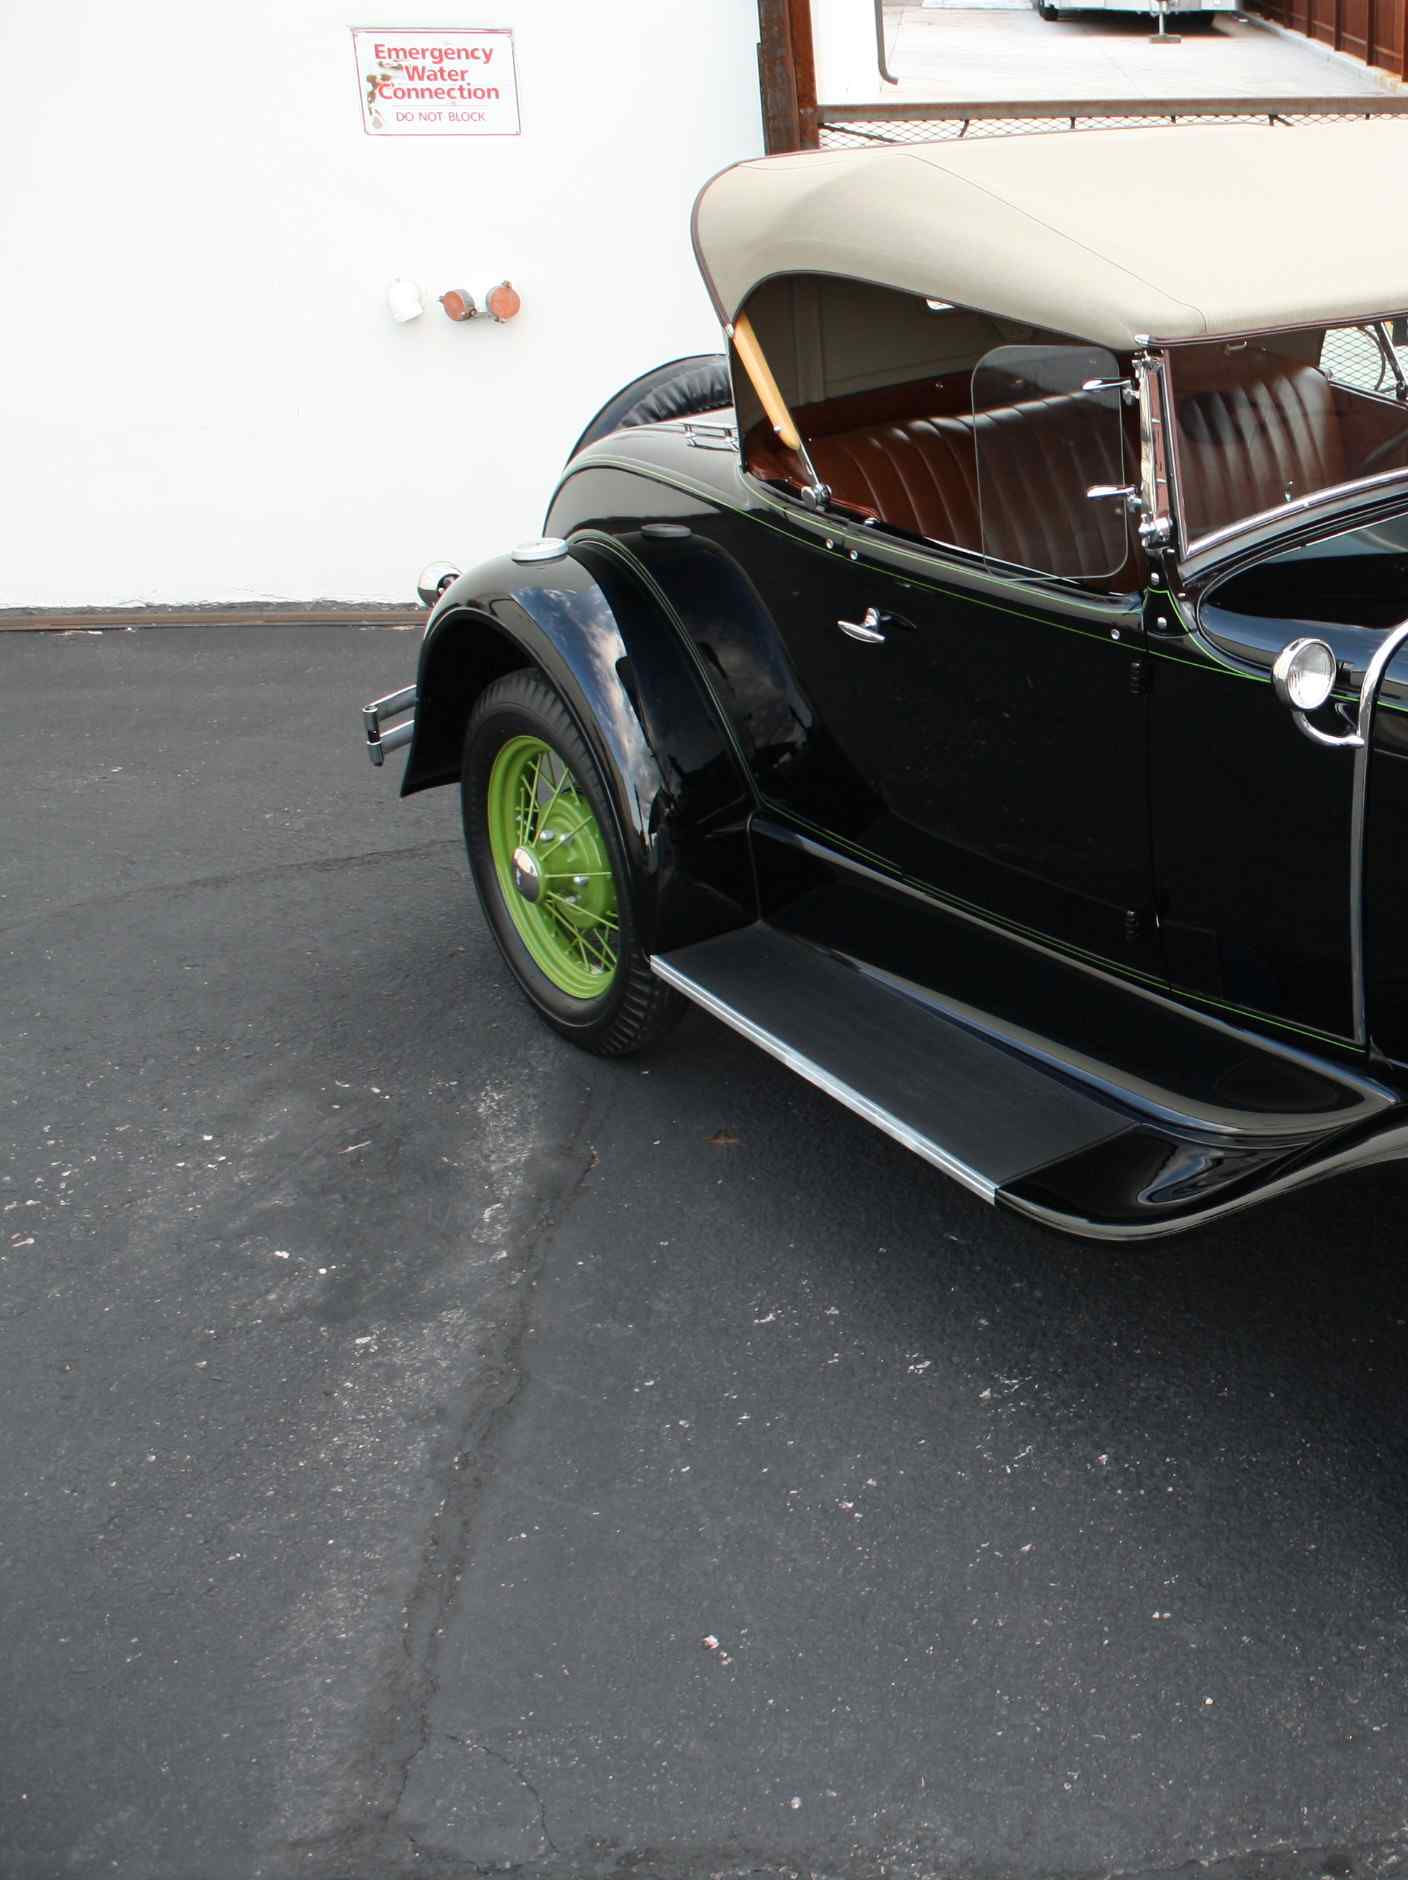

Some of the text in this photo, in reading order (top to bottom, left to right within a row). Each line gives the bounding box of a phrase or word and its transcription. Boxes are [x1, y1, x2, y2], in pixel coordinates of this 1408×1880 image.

[374, 43, 494, 64] Emergency
[402, 65, 469, 82] Water
[378, 83, 500, 100] Connection
[396, 111, 487, 122] DO NOT BLOCK
